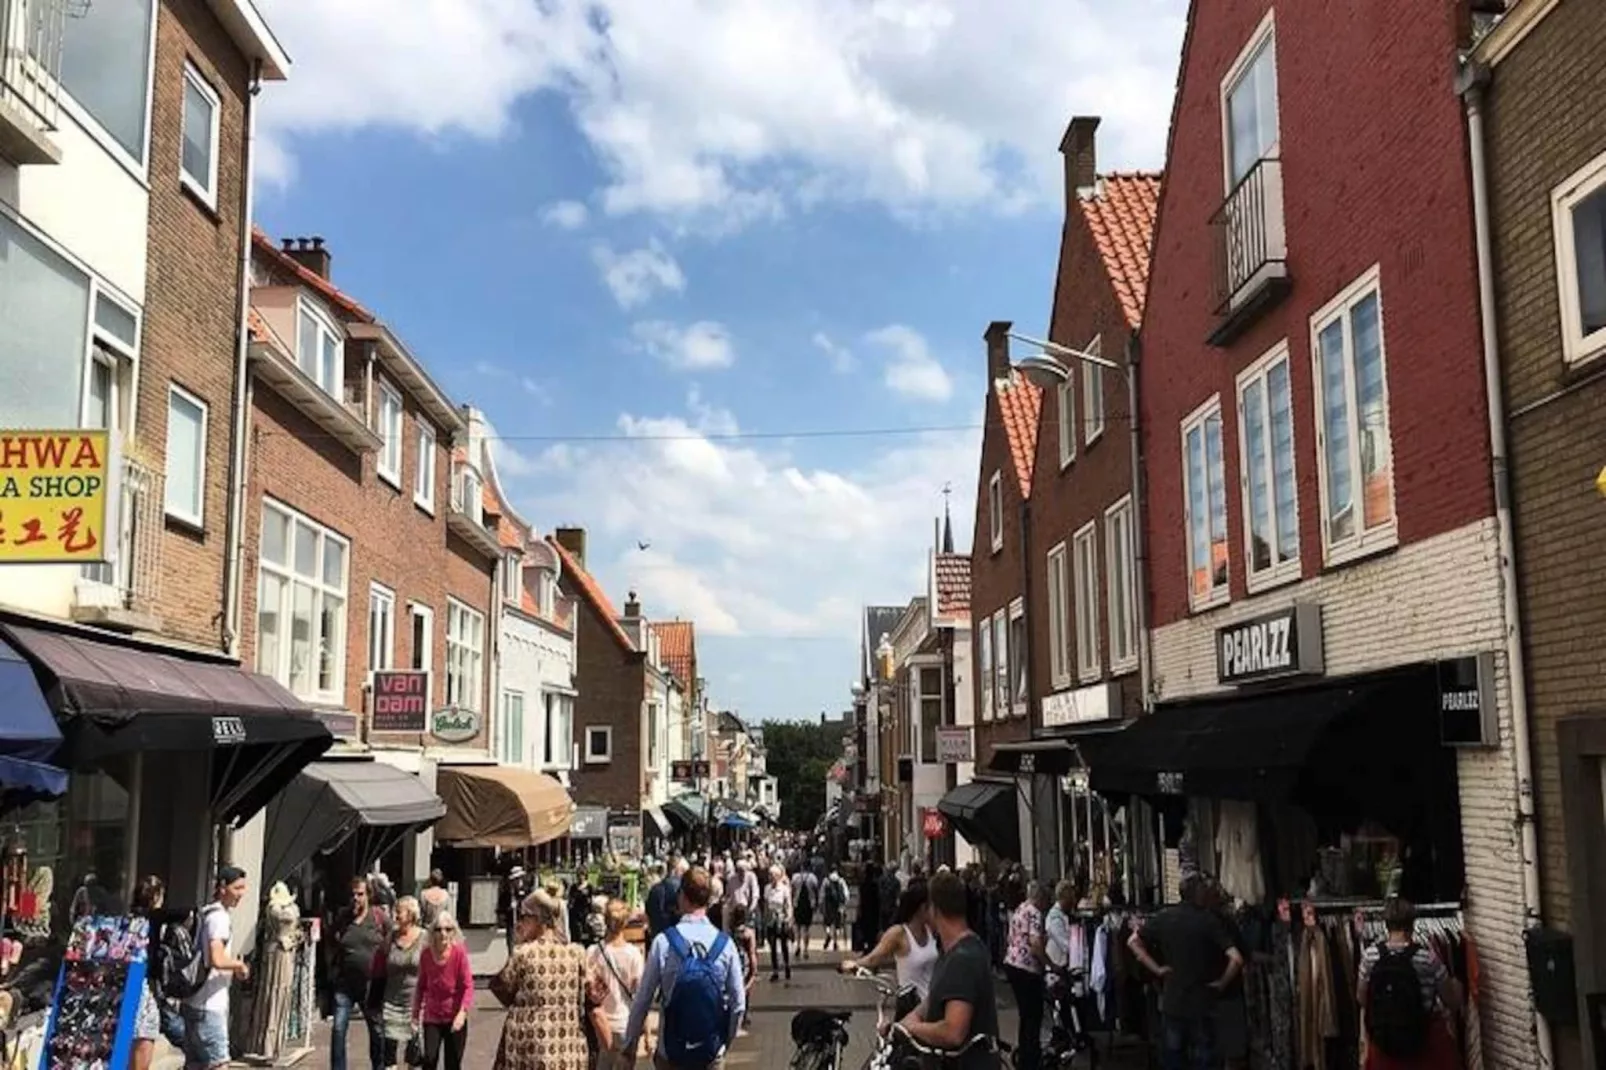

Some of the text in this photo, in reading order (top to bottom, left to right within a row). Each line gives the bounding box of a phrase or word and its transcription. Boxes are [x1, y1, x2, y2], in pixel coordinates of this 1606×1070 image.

[0, 436, 101, 469] HWA
[29, 475, 101, 498] SHOP
[1223, 616, 1291, 676] PEARLZZ
[380, 675, 421, 692] van
